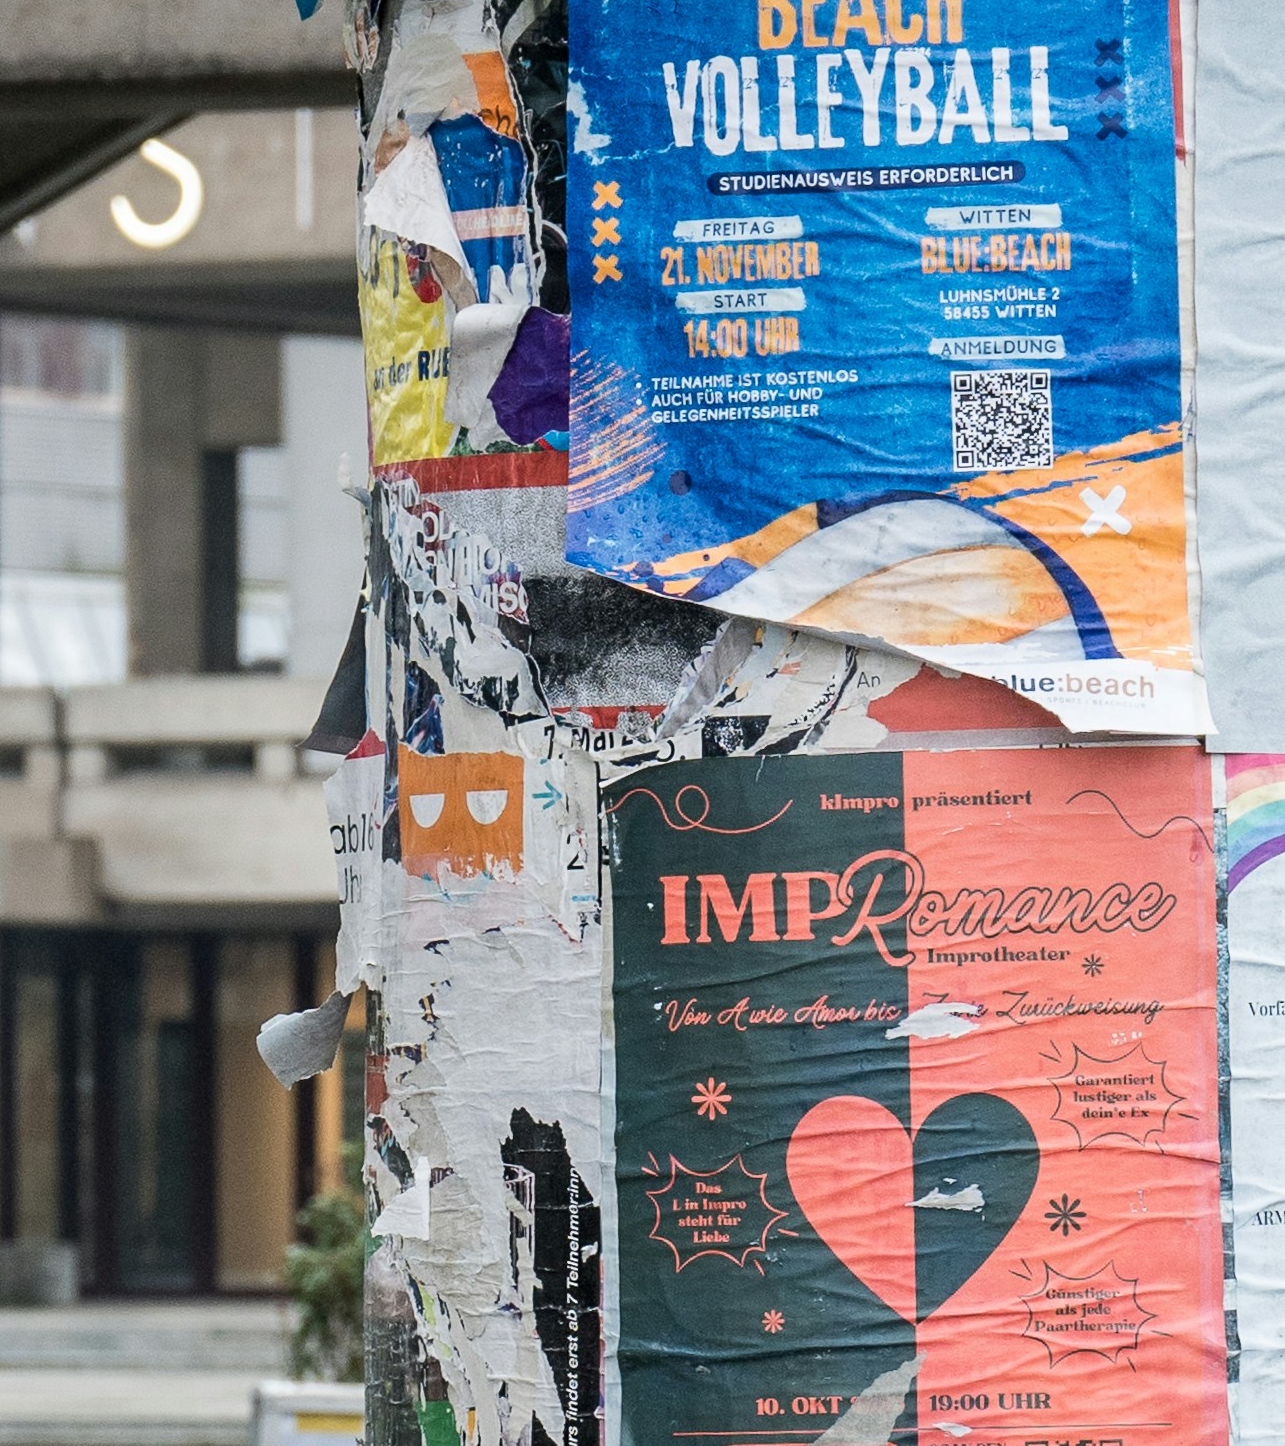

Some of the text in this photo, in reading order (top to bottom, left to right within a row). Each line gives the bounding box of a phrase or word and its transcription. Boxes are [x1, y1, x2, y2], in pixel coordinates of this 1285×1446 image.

[663, 45, 1068, 155] VOLLEYBALL
[719, 164, 1014, 191] STUDIENAUSWEIS ERFORDERLICH
[959, 207, 1032, 224] WITTEN
[703, 220, 775, 237] FREITAG
[660, 241, 820, 286] 21. NOVEMBER
[921, 233, 1071, 275] BLUE:BEACH
[714, 292, 767, 309] START
[939, 286, 1060, 305] LUHNSMÜHLE 2
[944, 303, 1057, 319] 58455 WITTEN
[683, 317, 799, 358] 14:00 UHR
[941, 337, 1056, 356] ANMELDUNG
[652, 368, 858, 389] TEILNAHME IST KOSTENLOS
[651, 385, 823, 405] AUCH FÜR HOBBY- UND
[652, 403, 818, 423] GELEGENHEITSSPIELER
[820, 790, 1032, 813] kImpro präsentiert
[927, 947, 1070, 966] Improtheater
[665, 991, 1163, 1032] Von A wie Amor bis Zurückweisung
[1075, 1074, 1154, 1087] Garantiert
[1074, 1089, 1157, 1104] lustiger als
[1131, 1108, 1149, 1118] Ex
[695, 1183, 721, 1194] Das
[685, 1199, 699, 1210] in
[703, 1199, 746, 1213] Impro
[679, 1215, 740, 1227] steht für
[693, 1231, 730, 1243] Liebe
[567, 1294, 579, 1305] 7
[1046, 1287, 1119, 1303] Günstiger
[566, 1308, 579, 1332] ab
[1055, 1304, 1111, 1319] als jede
[1034, 1319, 1137, 1335] Paartherapie
[568, 1336, 579, 1368] erst
[565, 1373, 579, 1423] findet
[756, 1392, 1051, 1416] 10. OKT 19:00 UHR
